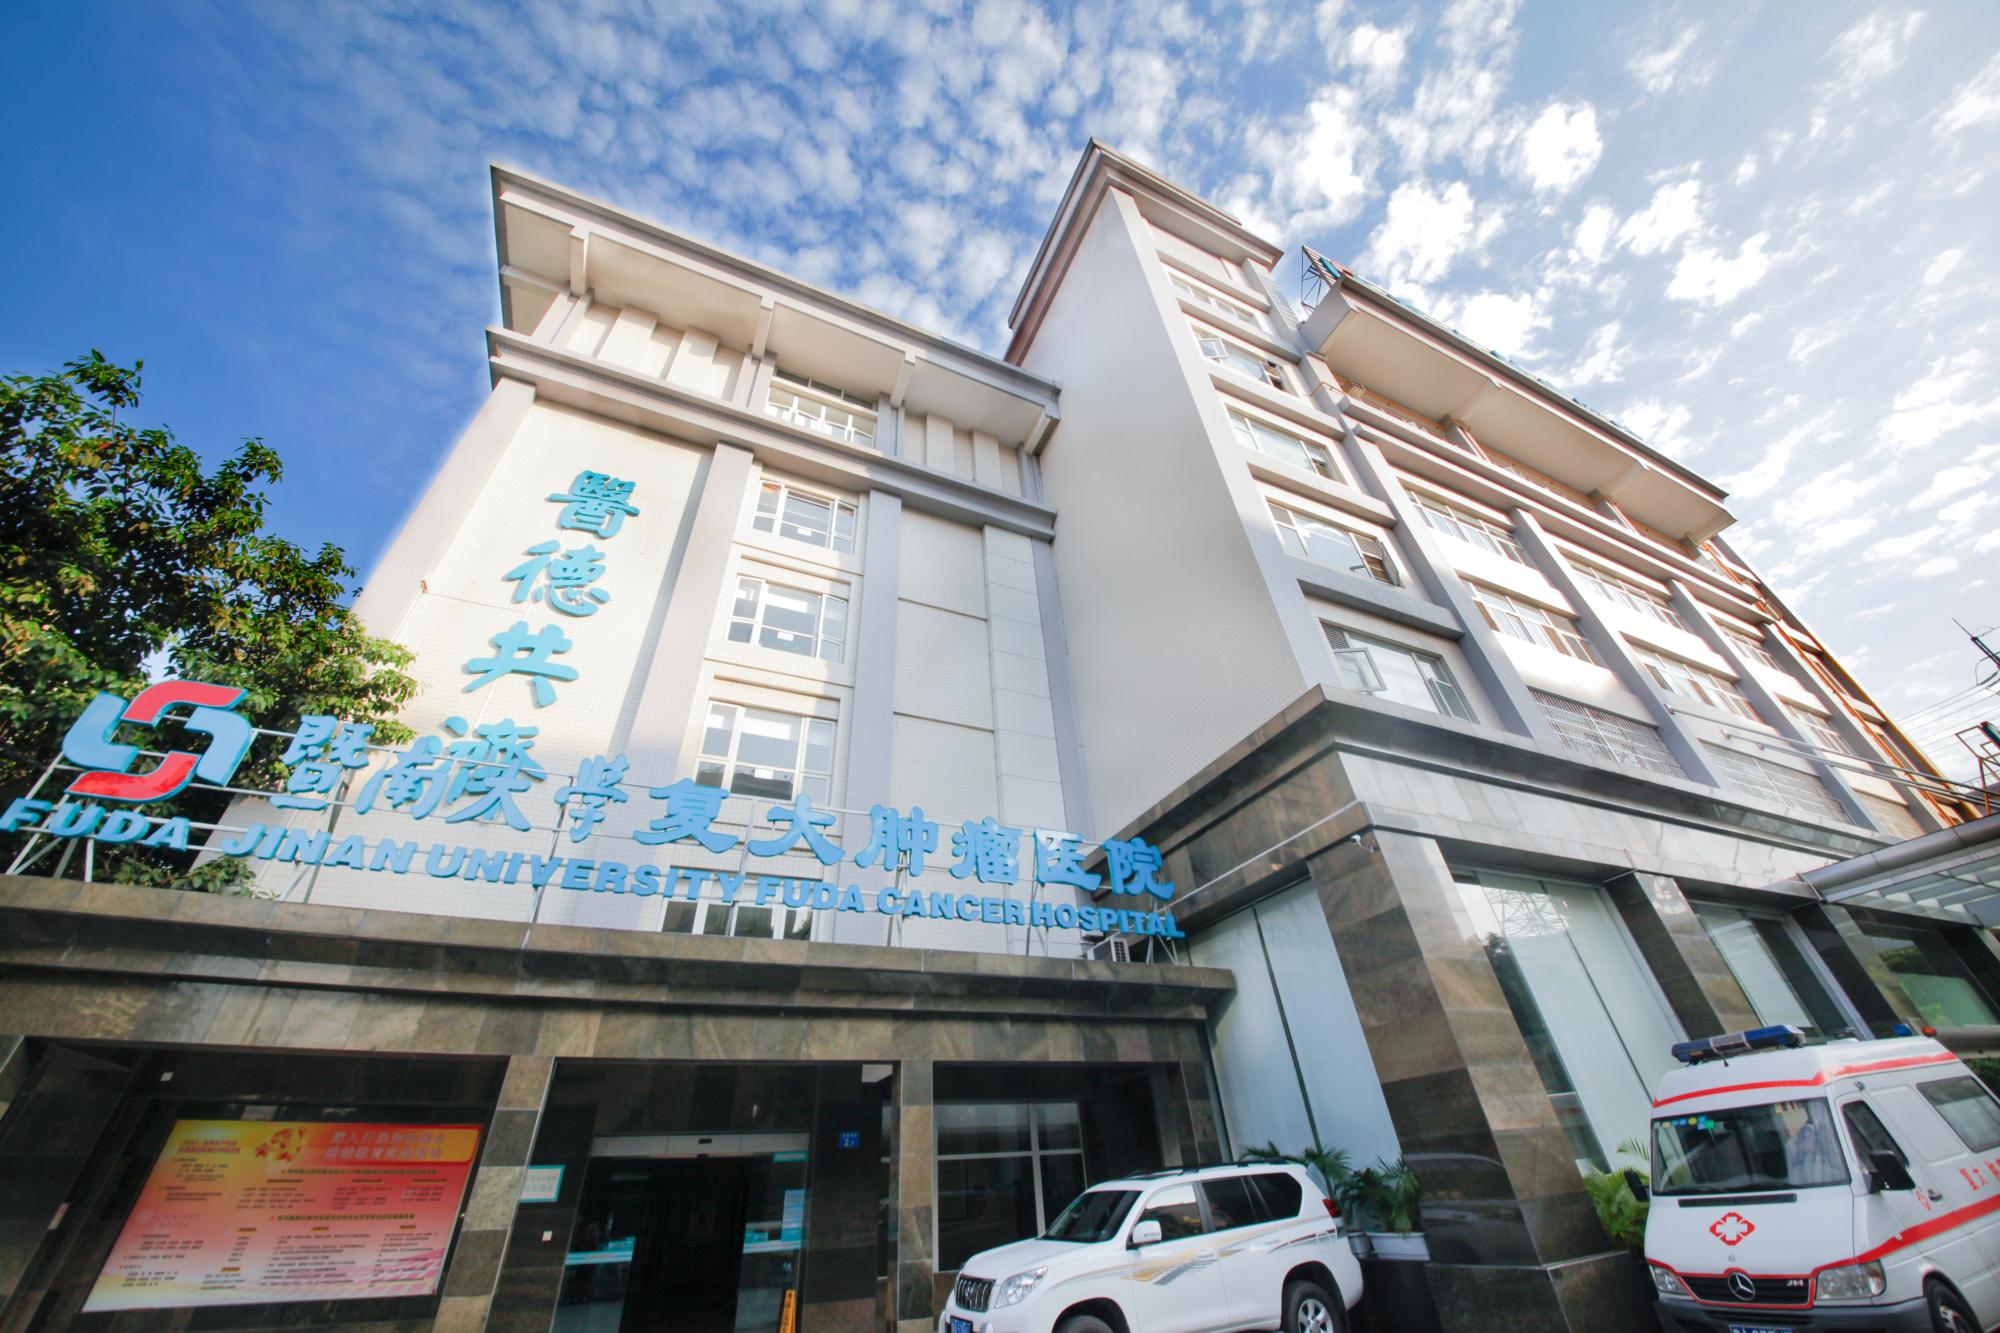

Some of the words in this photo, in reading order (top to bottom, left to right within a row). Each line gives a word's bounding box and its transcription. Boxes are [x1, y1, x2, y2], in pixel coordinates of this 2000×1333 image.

[0, 798, 190, 852] FUDA
[221, 824, 417, 873] JINAN
[425, 846, 744, 902] UNIVERSITY
[754, 876, 865, 914] FUDA
[877, 888, 1026, 926] CANCER
[1031, 903, 1186, 939] HOSPITAL
